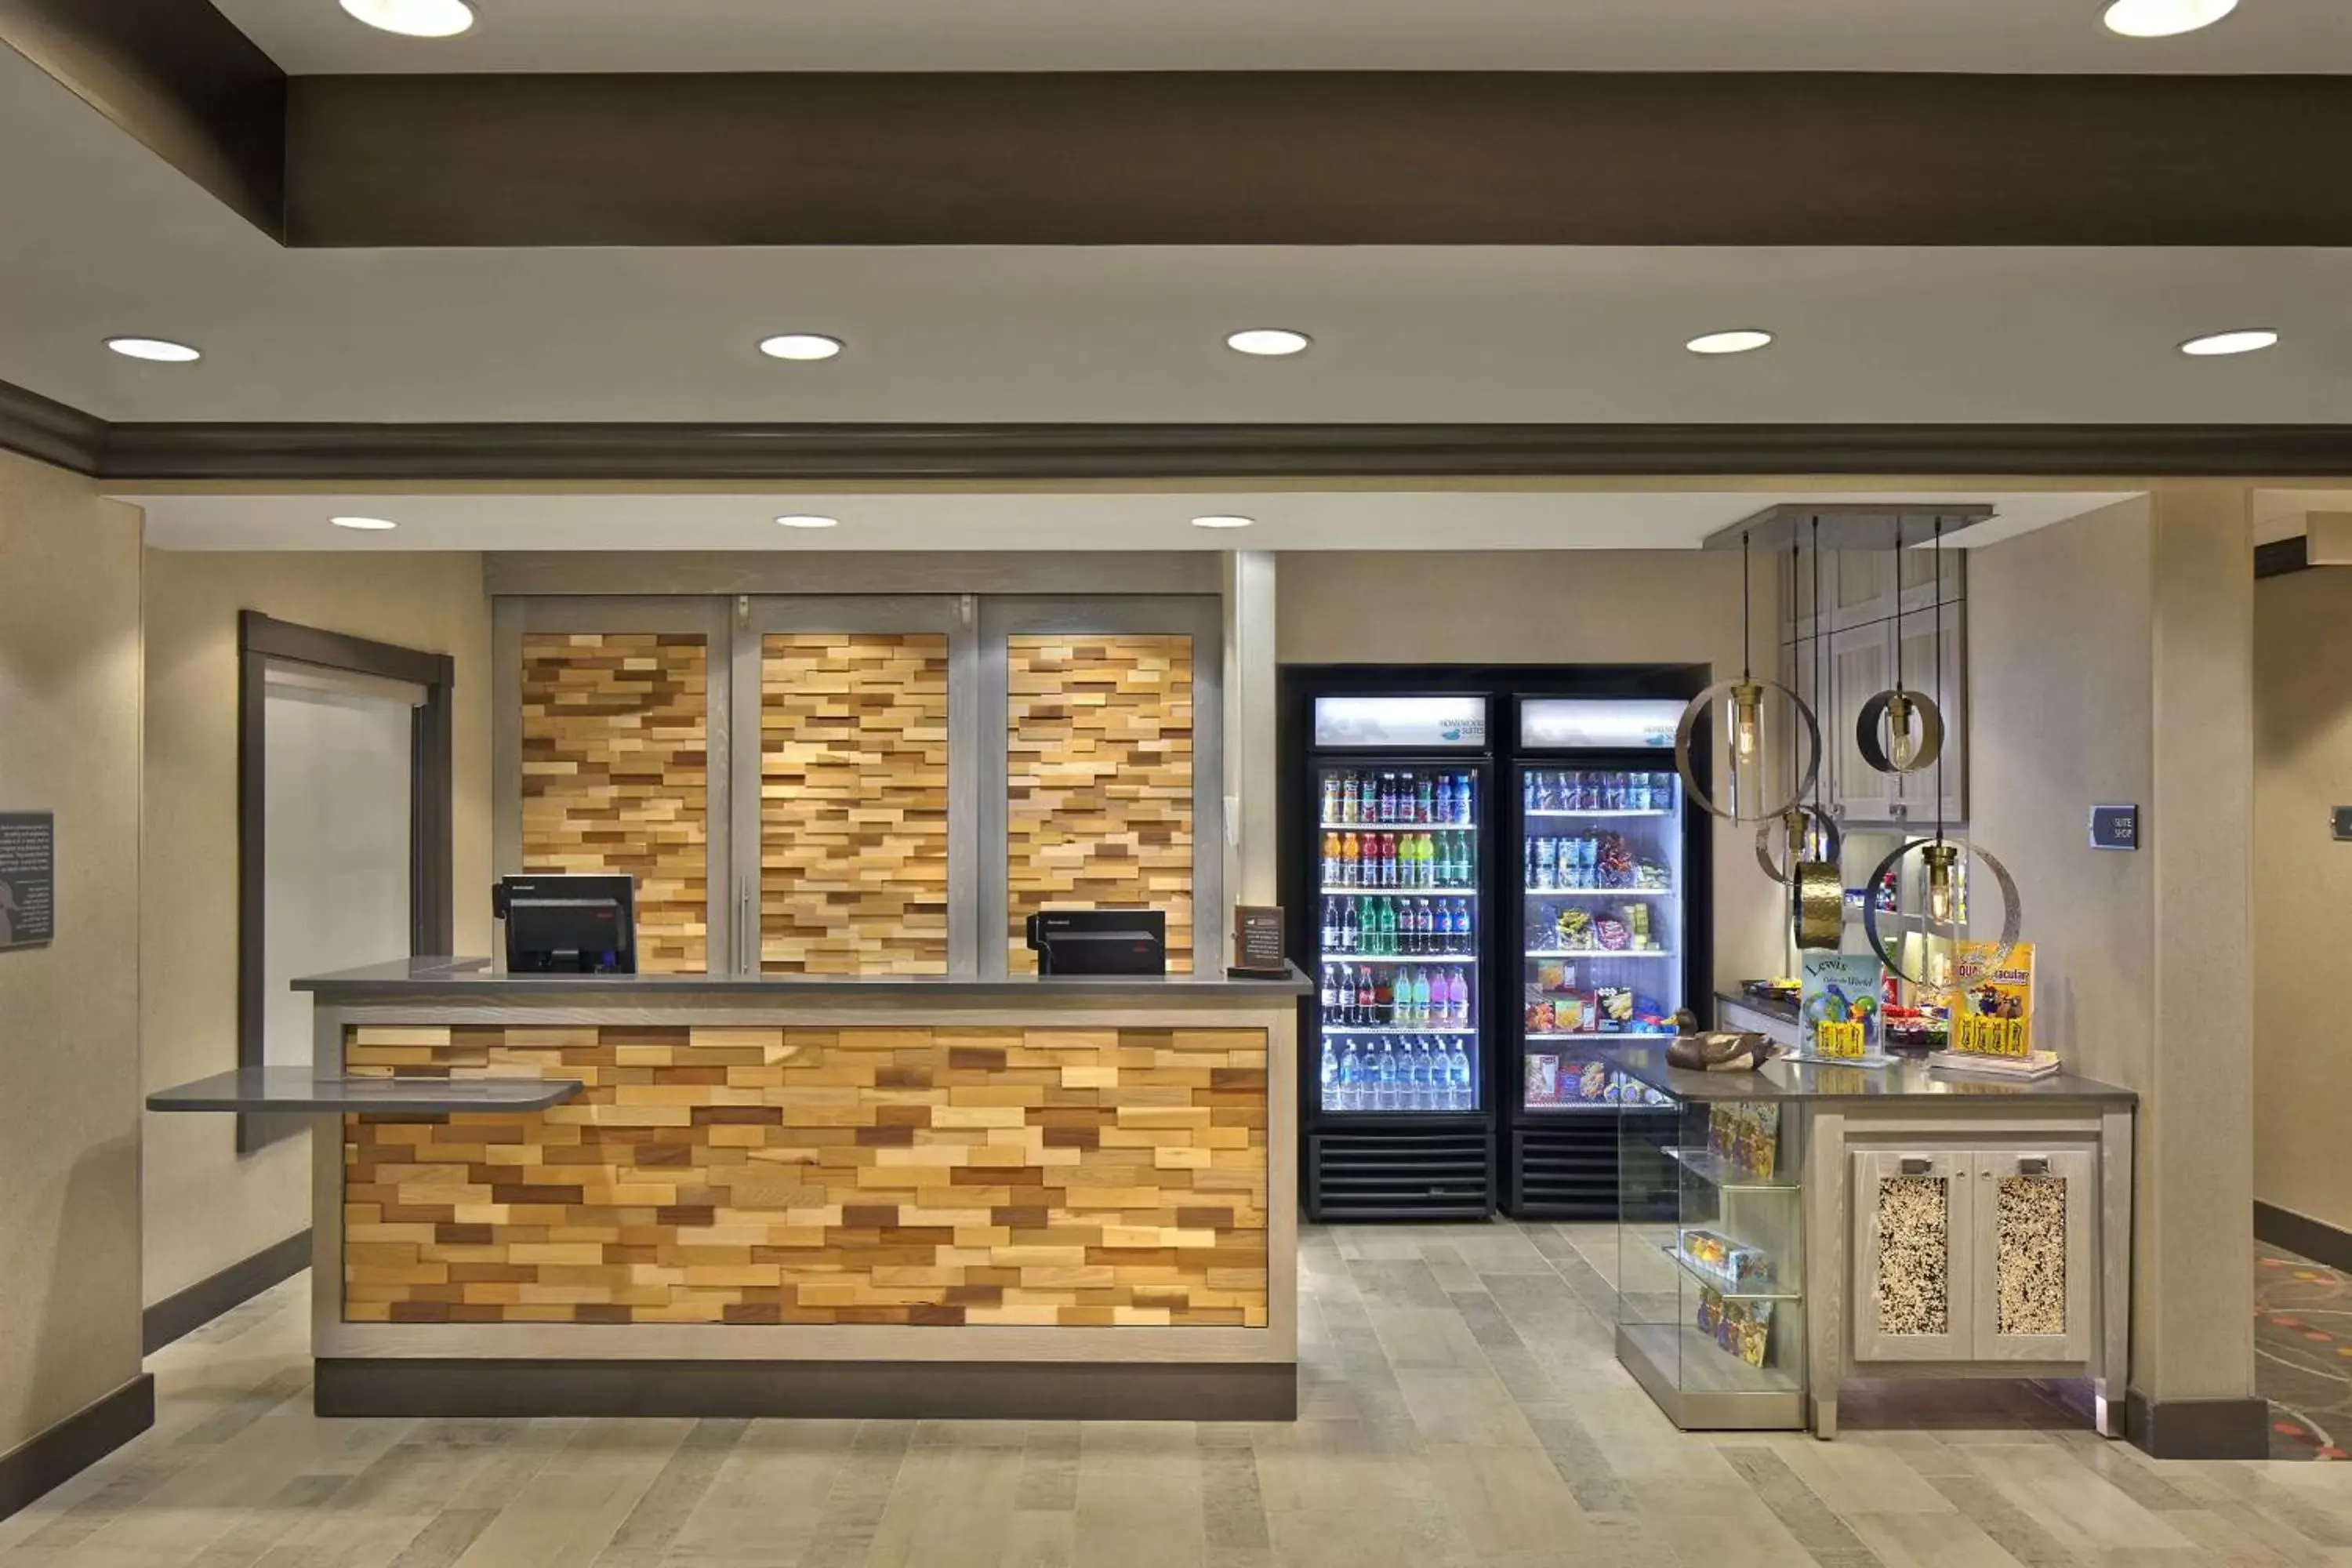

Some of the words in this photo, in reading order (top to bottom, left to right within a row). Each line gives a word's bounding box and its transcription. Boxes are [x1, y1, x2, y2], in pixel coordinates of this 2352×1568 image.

[2114, 818, 2132, 827] SUITE
[2114, 829, 2132, 839] SHOP
[1806, 956, 1848, 977] Lewis
